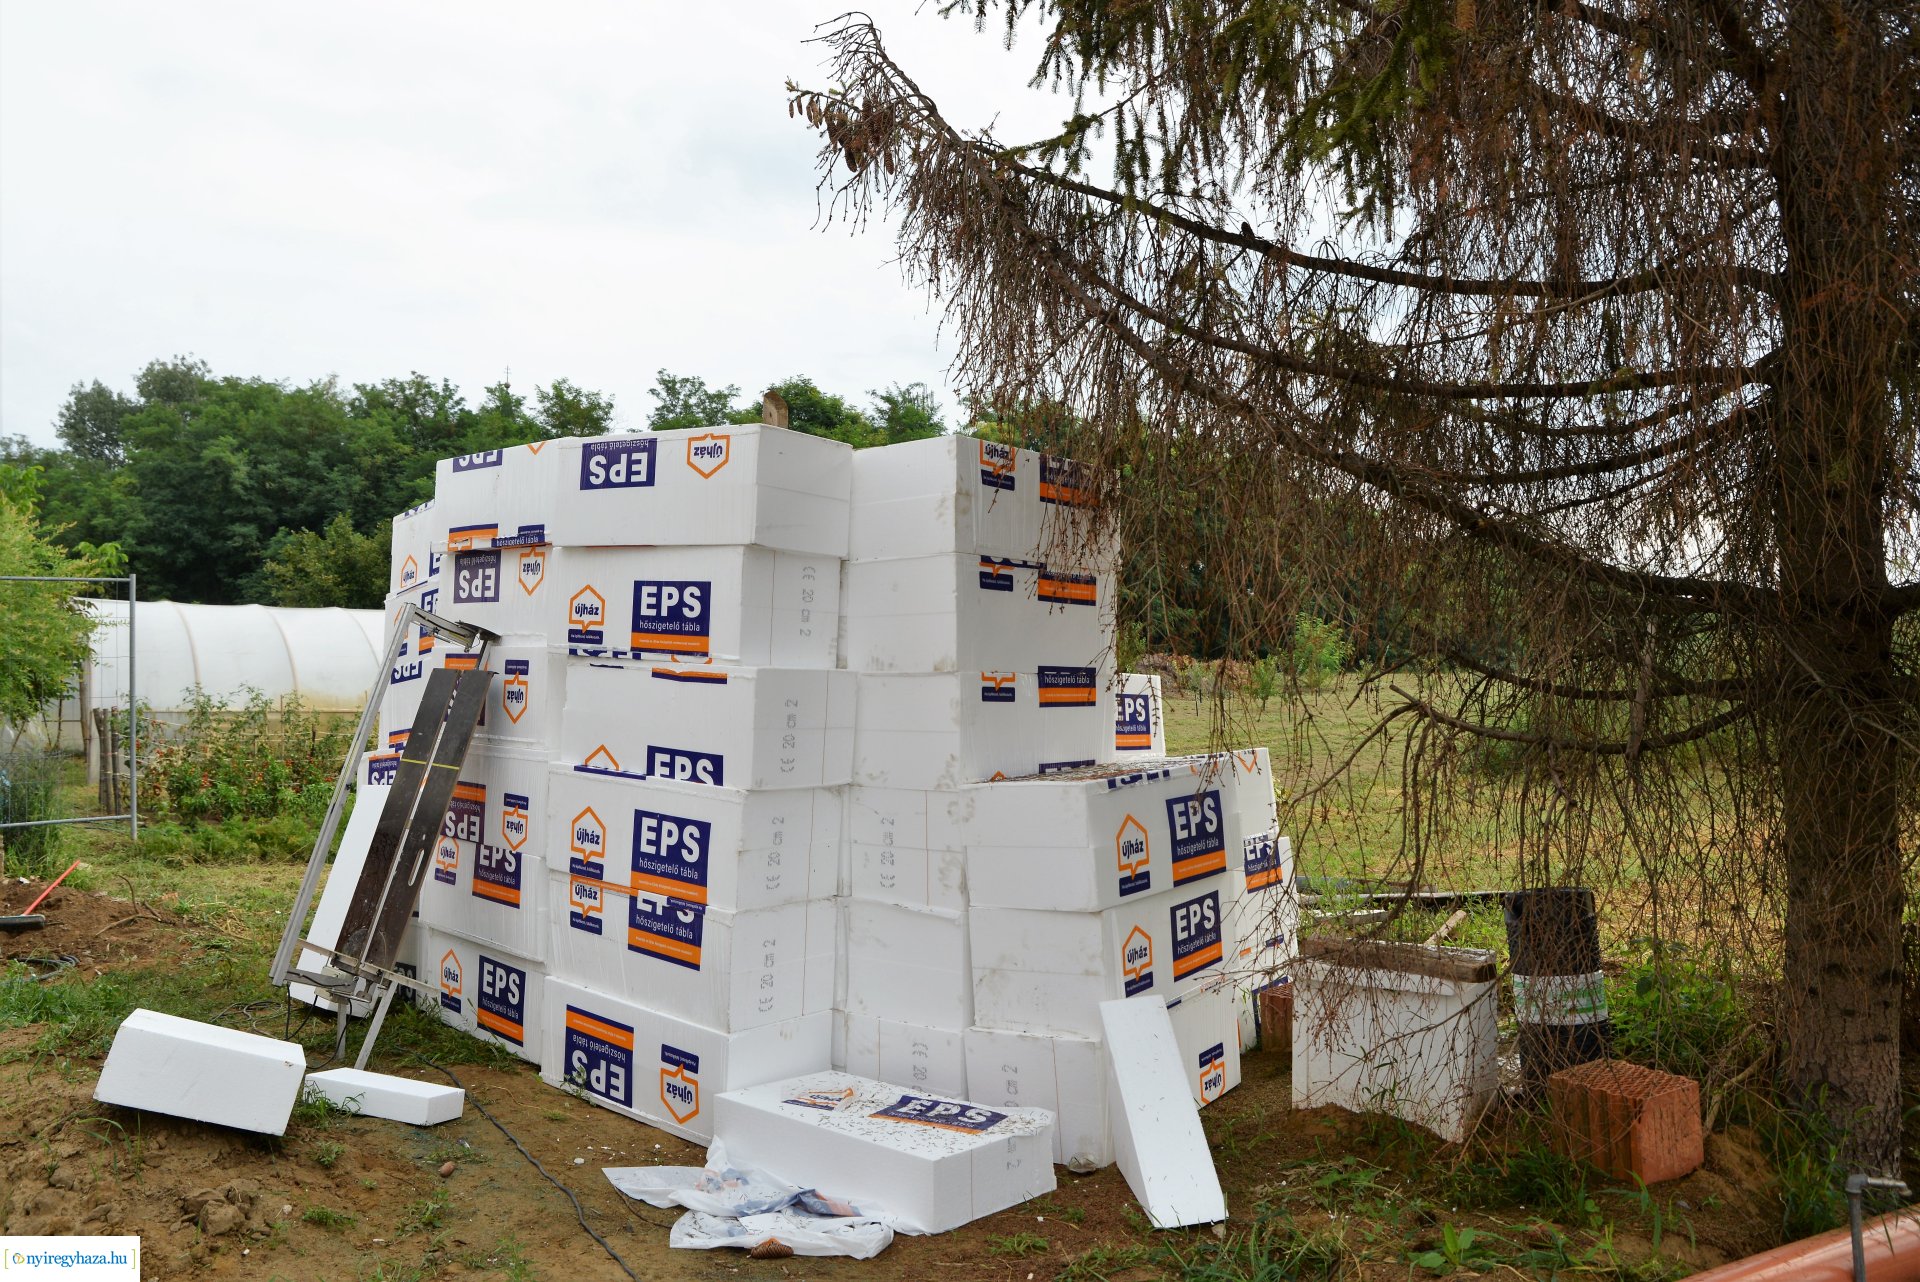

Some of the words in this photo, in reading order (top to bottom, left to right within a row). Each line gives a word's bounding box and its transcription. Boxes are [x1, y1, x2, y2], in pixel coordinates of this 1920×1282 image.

[590, 442, 608, 452] tábla
[693, 445, 723, 459] újház
[589, 452, 648, 485] EPS
[522, 557, 540, 576] újház
[459, 567, 496, 599] EPS
[574, 603, 600, 618] újház
[640, 585, 702, 618] EPS
[639, 620, 680, 632] hőszigetelő
[682, 620, 701, 632] tábla
[1044, 674, 1076, 685] hőszigetelő
[1076, 674, 1090, 684] tábla
[506, 688, 524, 704] újház
[654, 752, 714, 786] EPS
[444, 810, 481, 843] EPS
[506, 819, 524, 834] újház
[1172, 796, 1218, 840] EPS
[576, 828, 600, 846] újház
[640, 816, 700, 863] EPS
[1176, 841, 1206, 856] hőszigetelő
[1206, 836, 1219, 850] tábla
[479, 844, 516, 873] EPS
[1121, 838, 1144, 860] újház
[638, 857, 678, 875] hőszigetelő
[680, 865, 699, 880] tábla
[574, 884, 598, 901] újház
[635, 914, 674, 934] hőszigetelő
[675, 926, 694, 940] tábla
[1175, 897, 1215, 942] EPS
[1126, 944, 1148, 966] újház
[444, 966, 459, 984] újház
[482, 961, 520, 1006] EPS
[572, 1034, 589, 1048] tábla
[589, 1040, 626, 1063] hőszigetelő
[571, 1050, 626, 1102] EPS
[666, 1082, 694, 1104] újház
[896, 1100, 992, 1123] EPS
